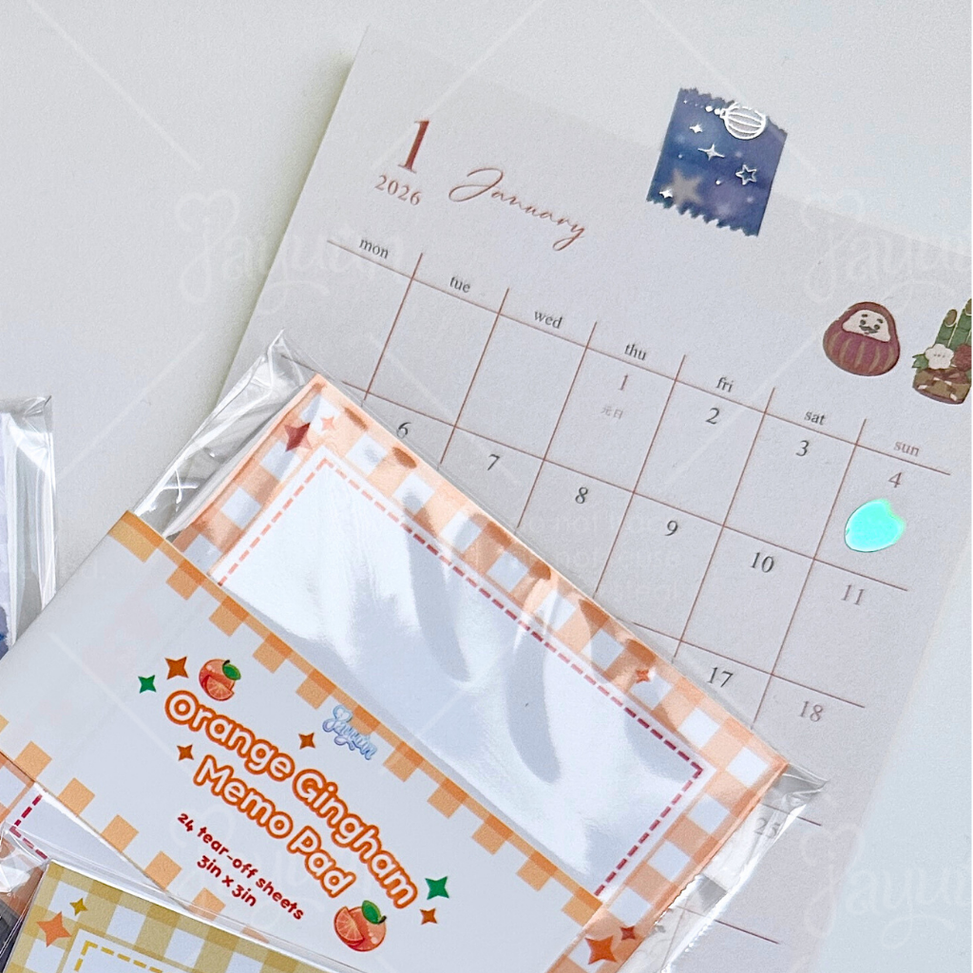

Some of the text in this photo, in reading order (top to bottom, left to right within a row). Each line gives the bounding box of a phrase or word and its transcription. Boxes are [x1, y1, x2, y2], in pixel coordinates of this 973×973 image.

[375, 174, 421, 207] 2026
[398, 119, 430, 174] 1
[449, 166, 586, 251] January
[358, 237, 921, 457] mon tue wed thu fri sat sun
[618, 374, 904, 490] 1 2 3 4
[395, 421, 865, 607] 6 7 8 9 10 11
[708, 667, 824, 724] 17 18
[164, 689, 296, 783] Orange
[291, 768, 419, 910] Gingham
[192, 754, 294, 840] Memo
[286, 825, 357, 899] Pad
[754, 816, 781, 840] 25
[177, 812, 305, 921] 24 tear-off sheets
[196, 853, 259, 908] 3in x 3in
